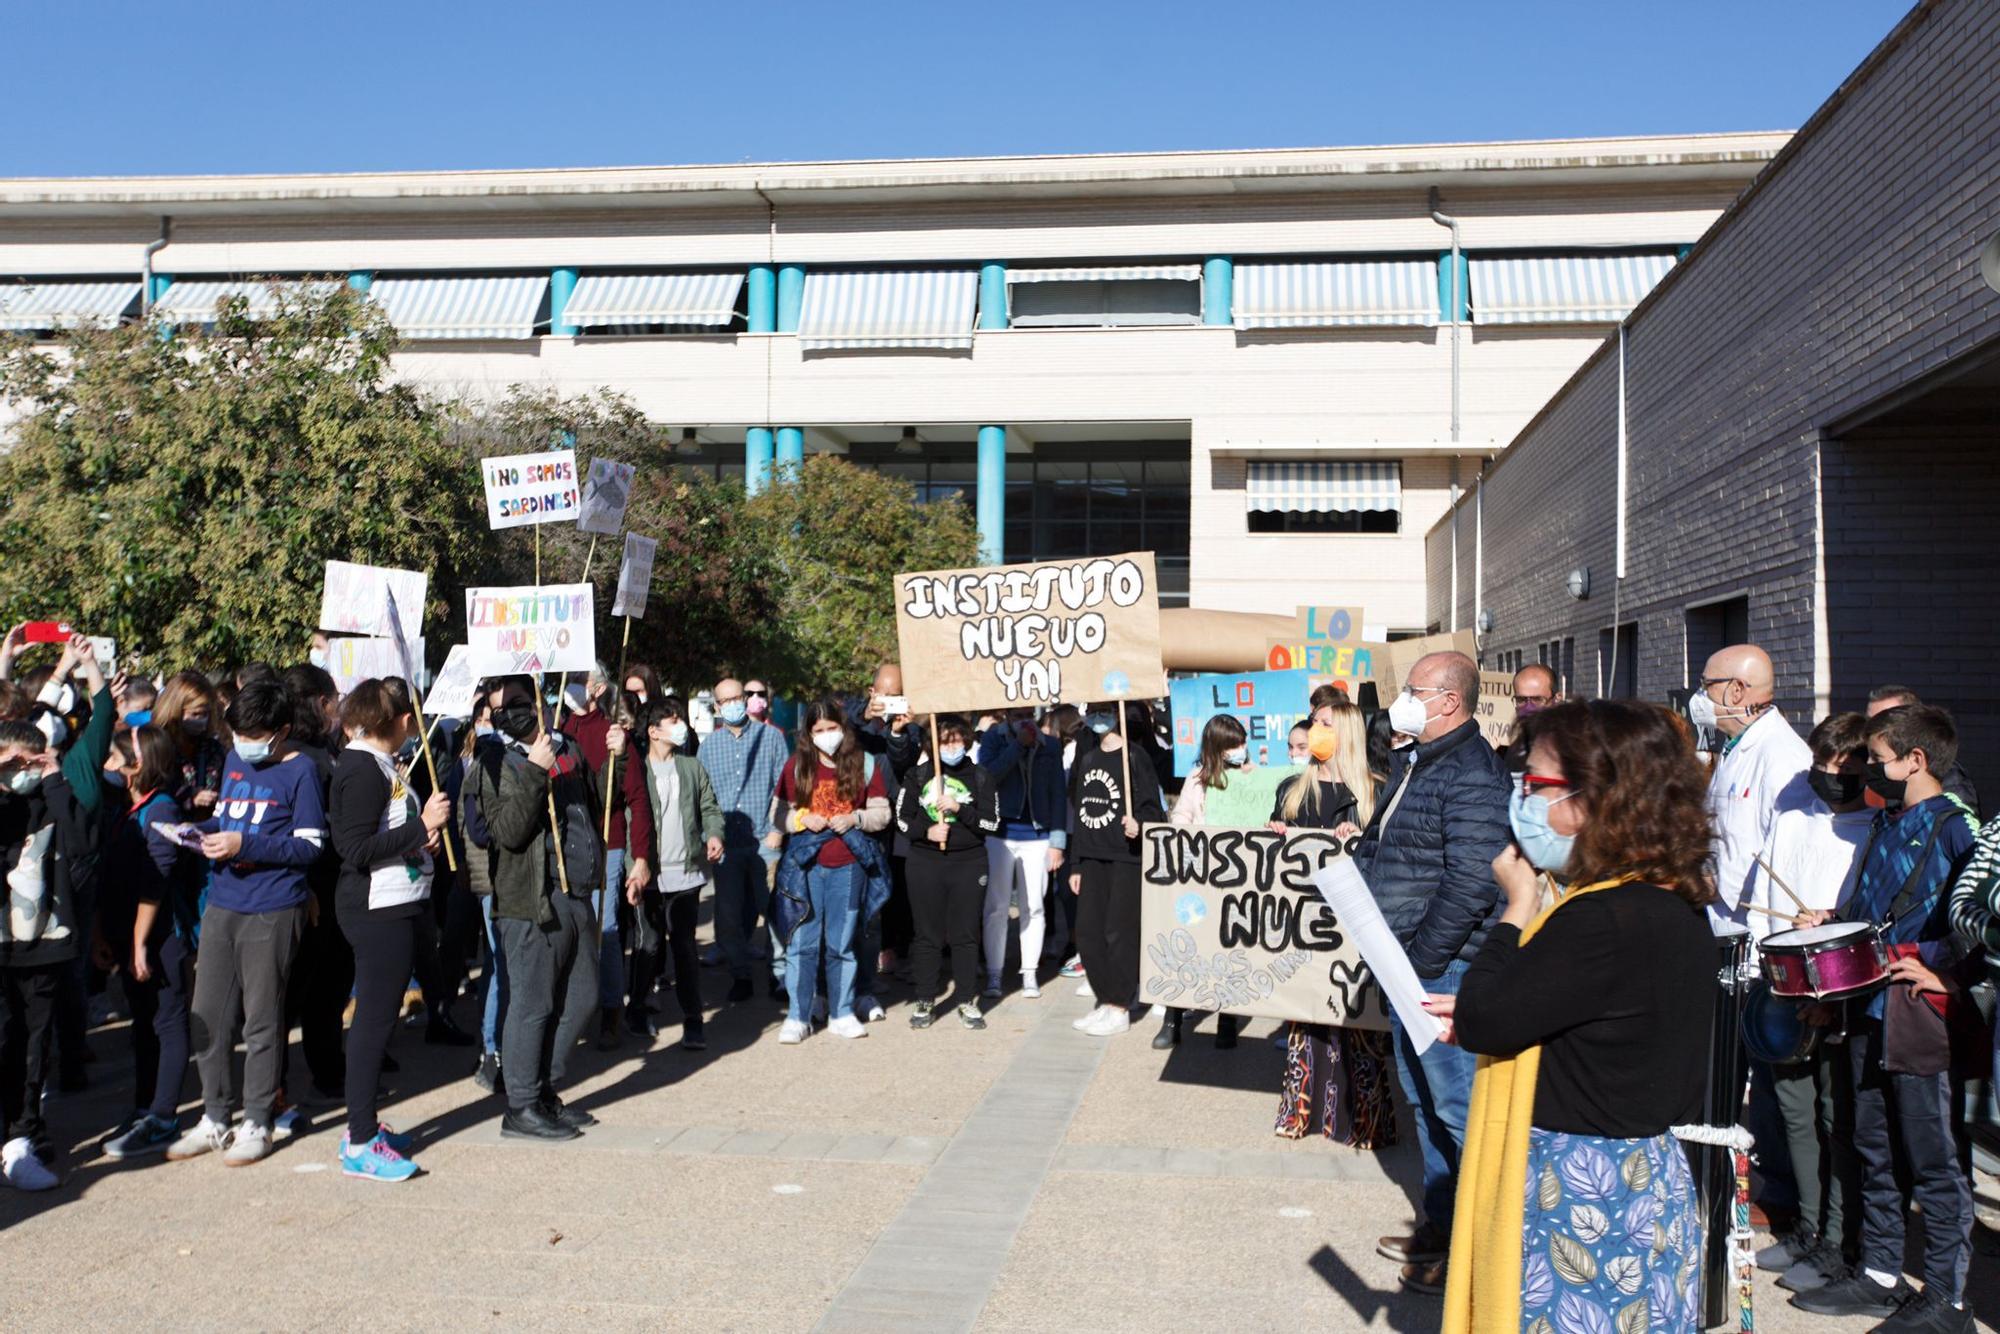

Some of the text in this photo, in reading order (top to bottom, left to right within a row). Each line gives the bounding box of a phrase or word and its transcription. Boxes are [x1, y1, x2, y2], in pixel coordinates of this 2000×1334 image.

[527, 462, 572, 484] SOMOS
[499, 489, 577, 517] SARDINAS!
[904, 558, 1143, 619] INSTITUTO
[497, 627, 570, 652] NUEVO
[1307, 607, 1351, 641] LO
[1269, 644, 1374, 677] QUEREM
[994, 659, 1061, 704] YA!
[1212, 681, 1254, 708] LO
[1144, 826, 1361, 892] INSTI
[1147, 928, 1198, 977] NO
